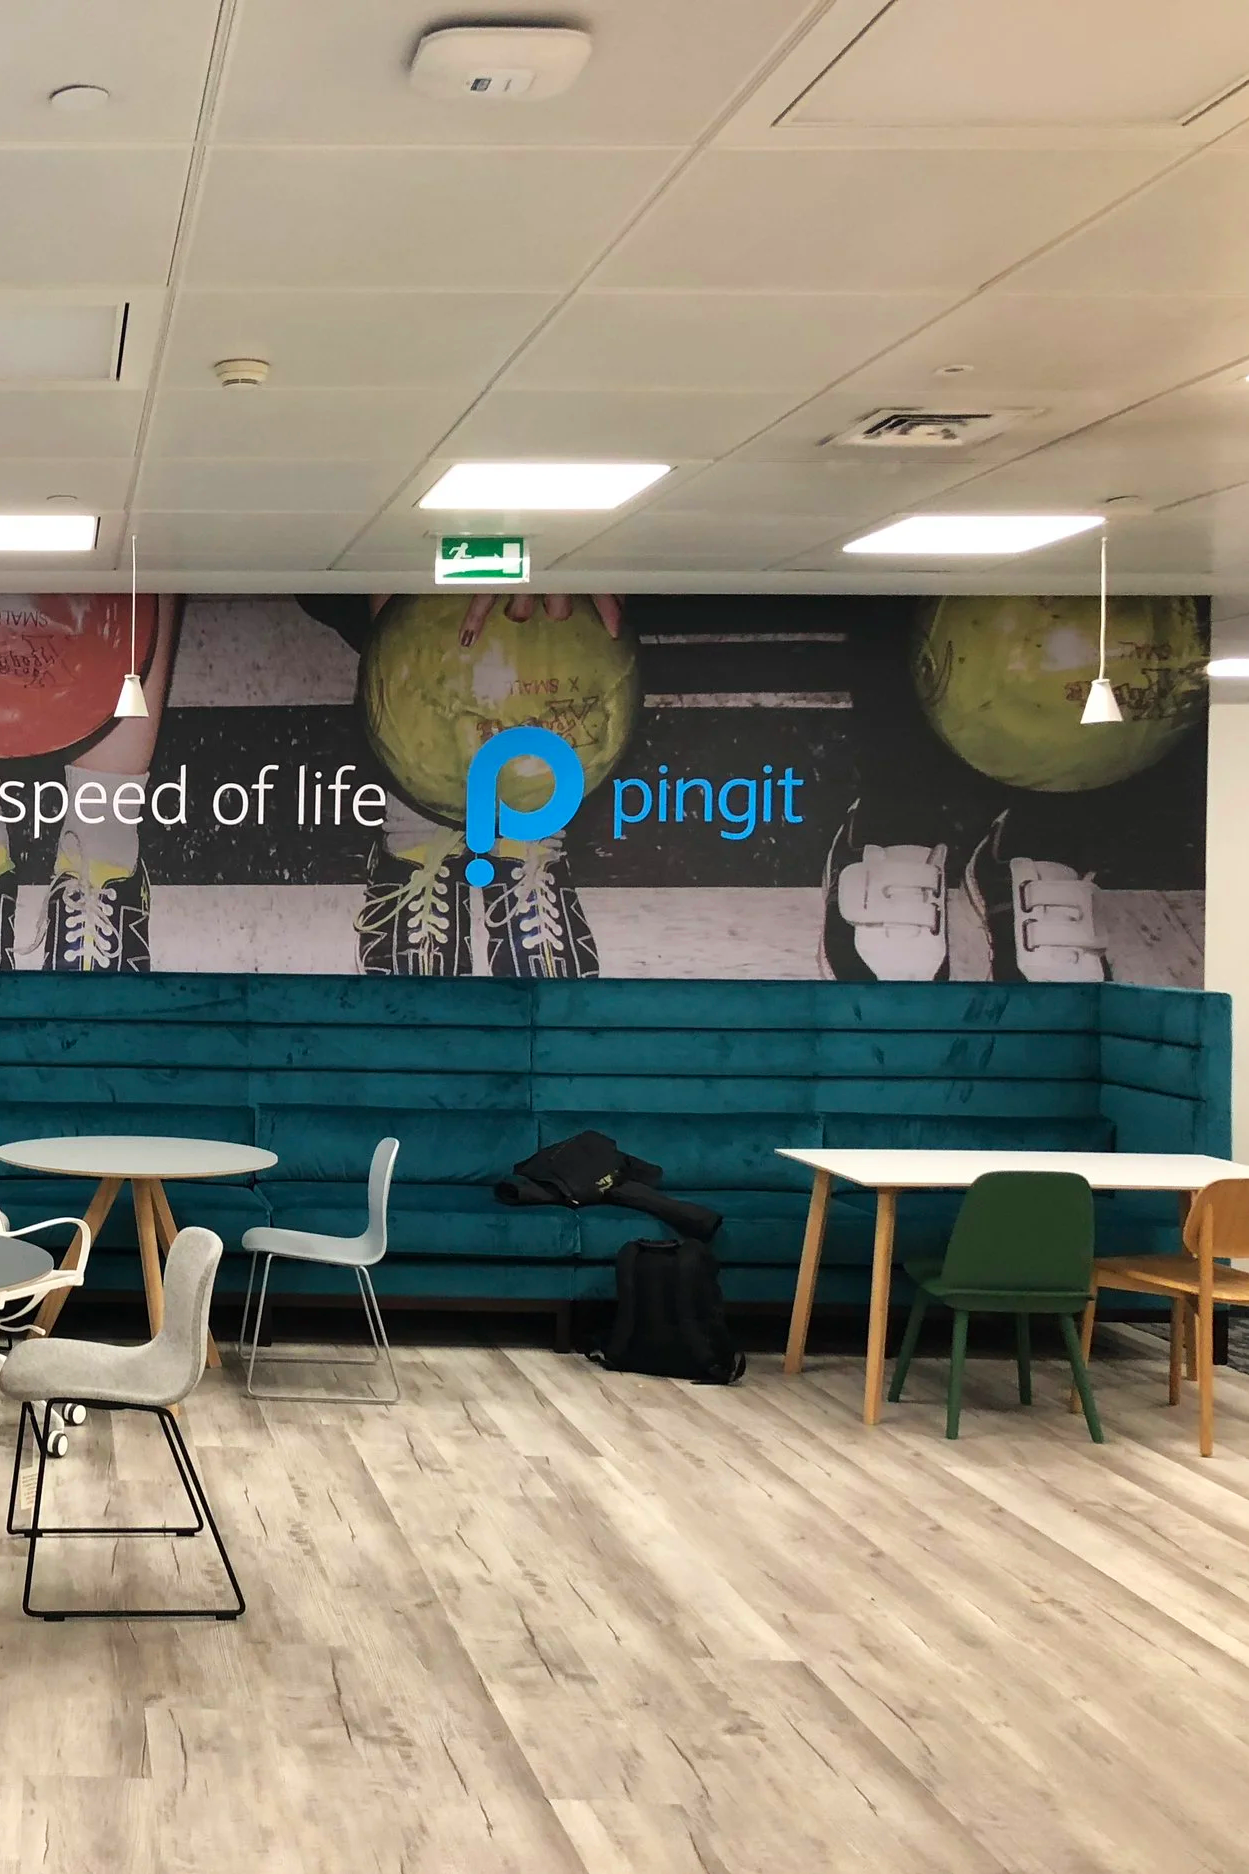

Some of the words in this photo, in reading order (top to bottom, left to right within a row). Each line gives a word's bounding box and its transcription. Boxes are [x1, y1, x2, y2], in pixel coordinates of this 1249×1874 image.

[212, 763, 279, 826] of
[298, 763, 387, 826] life
[613, 764, 804, 841] pingit
